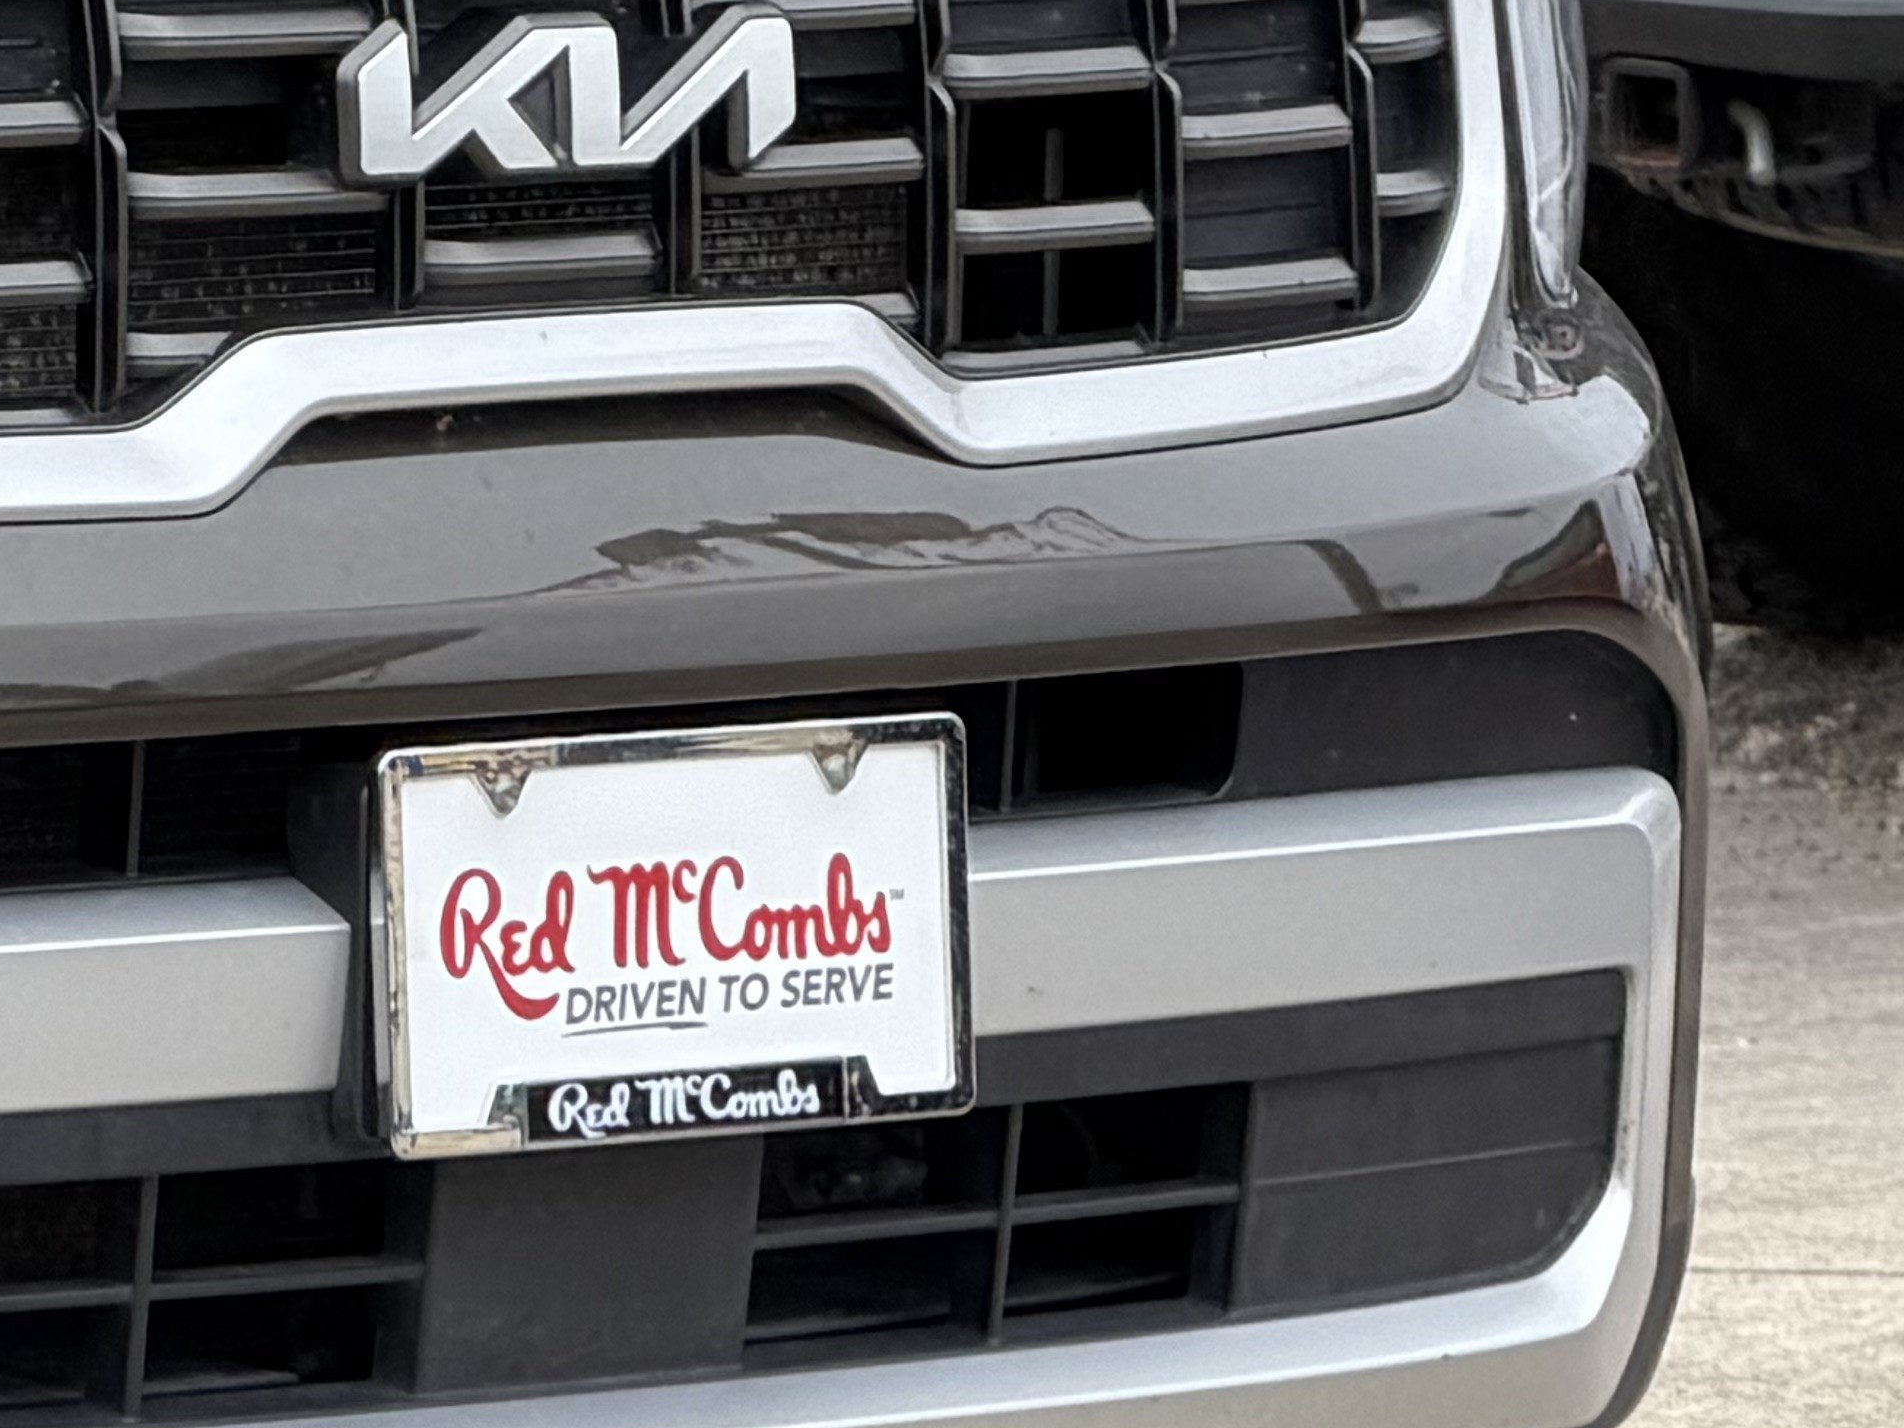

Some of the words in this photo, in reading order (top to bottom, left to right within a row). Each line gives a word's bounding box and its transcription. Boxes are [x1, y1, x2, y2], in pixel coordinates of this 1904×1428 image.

[340, 7, 796, 180] KIA
[438, 867, 577, 1021] Red
[586, 851, 893, 969] McCombs
[566, 978, 707, 1024] DRIVEN
[719, 975, 772, 1013] TO
[781, 963, 895, 1009] SERVE
[548, 1082, 632, 1139] Red
[635, 1068, 822, 1126] McCombs
